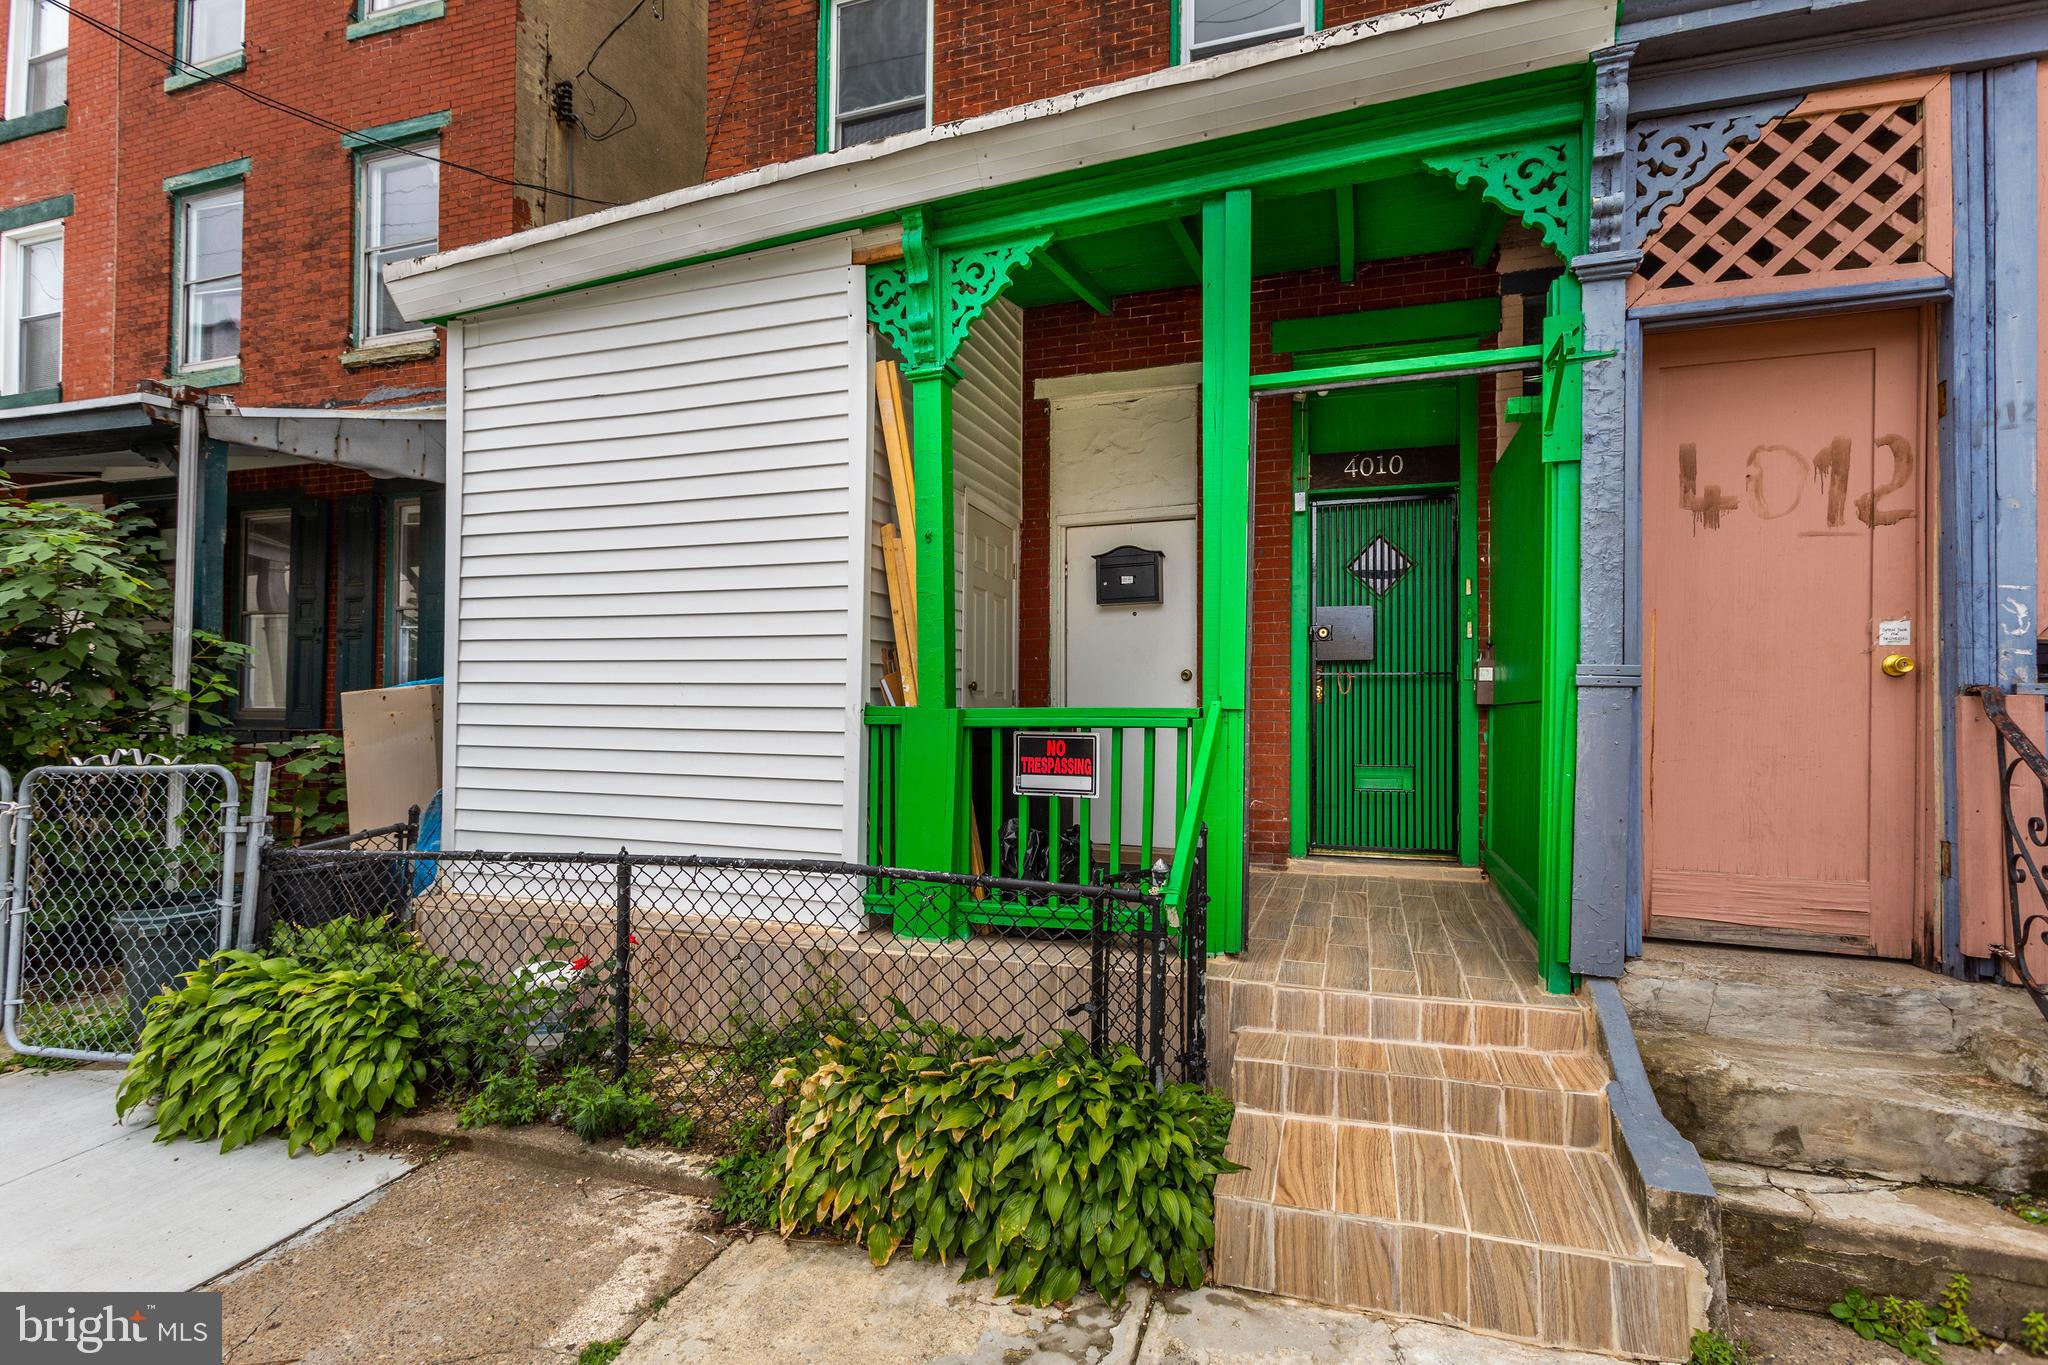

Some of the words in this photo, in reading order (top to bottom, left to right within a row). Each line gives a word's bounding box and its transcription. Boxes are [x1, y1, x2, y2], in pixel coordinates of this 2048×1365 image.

[1344, 454, 1404, 478] 4010
[1679, 434, 1919, 532] 4012
[1046, 739, 1066, 757] NO
[1020, 756, 1092, 775] TRESPASSING
